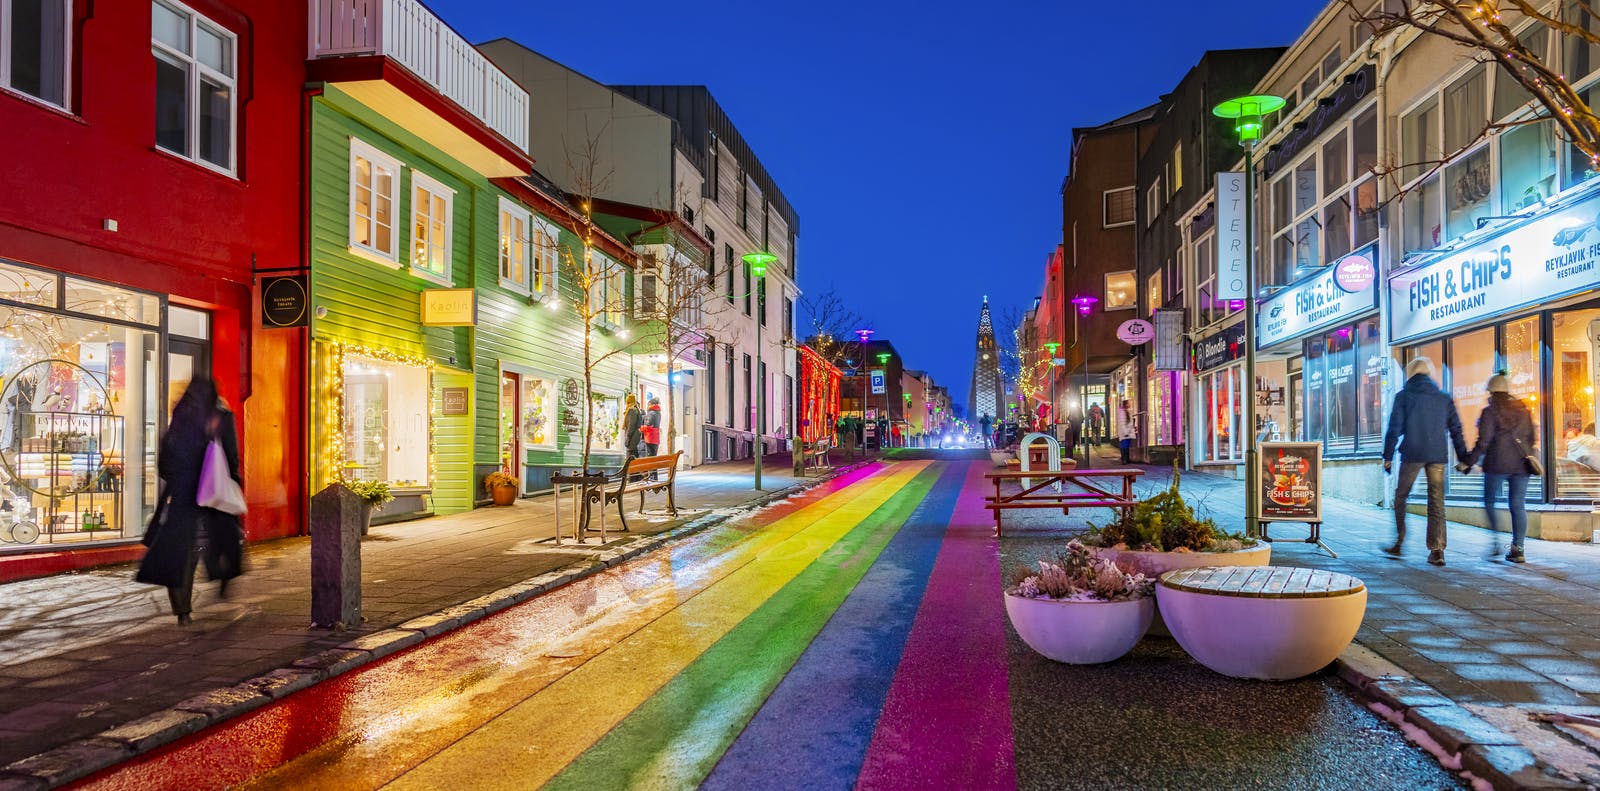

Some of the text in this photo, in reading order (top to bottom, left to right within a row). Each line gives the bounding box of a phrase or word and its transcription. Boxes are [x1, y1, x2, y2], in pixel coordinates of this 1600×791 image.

[1230, 178, 1243, 292] STEREO
[1545, 248, 1586, 272] REYKJAVIK
[1557, 260, 1595, 279] RESTAURANT
[1409, 244, 1512, 312] FISH & CHIPS
[1295, 286, 1315, 316] FISH
[1316, 283, 1325, 307] &
[1430, 292, 1486, 321] RESTAURANT
[1308, 302, 1341, 322] RESTAURANT
[1205, 336, 1227, 358] Blondie
[875, 377, 881, 385] P
[1266, 490, 1315, 498] FISH & CHIPS
